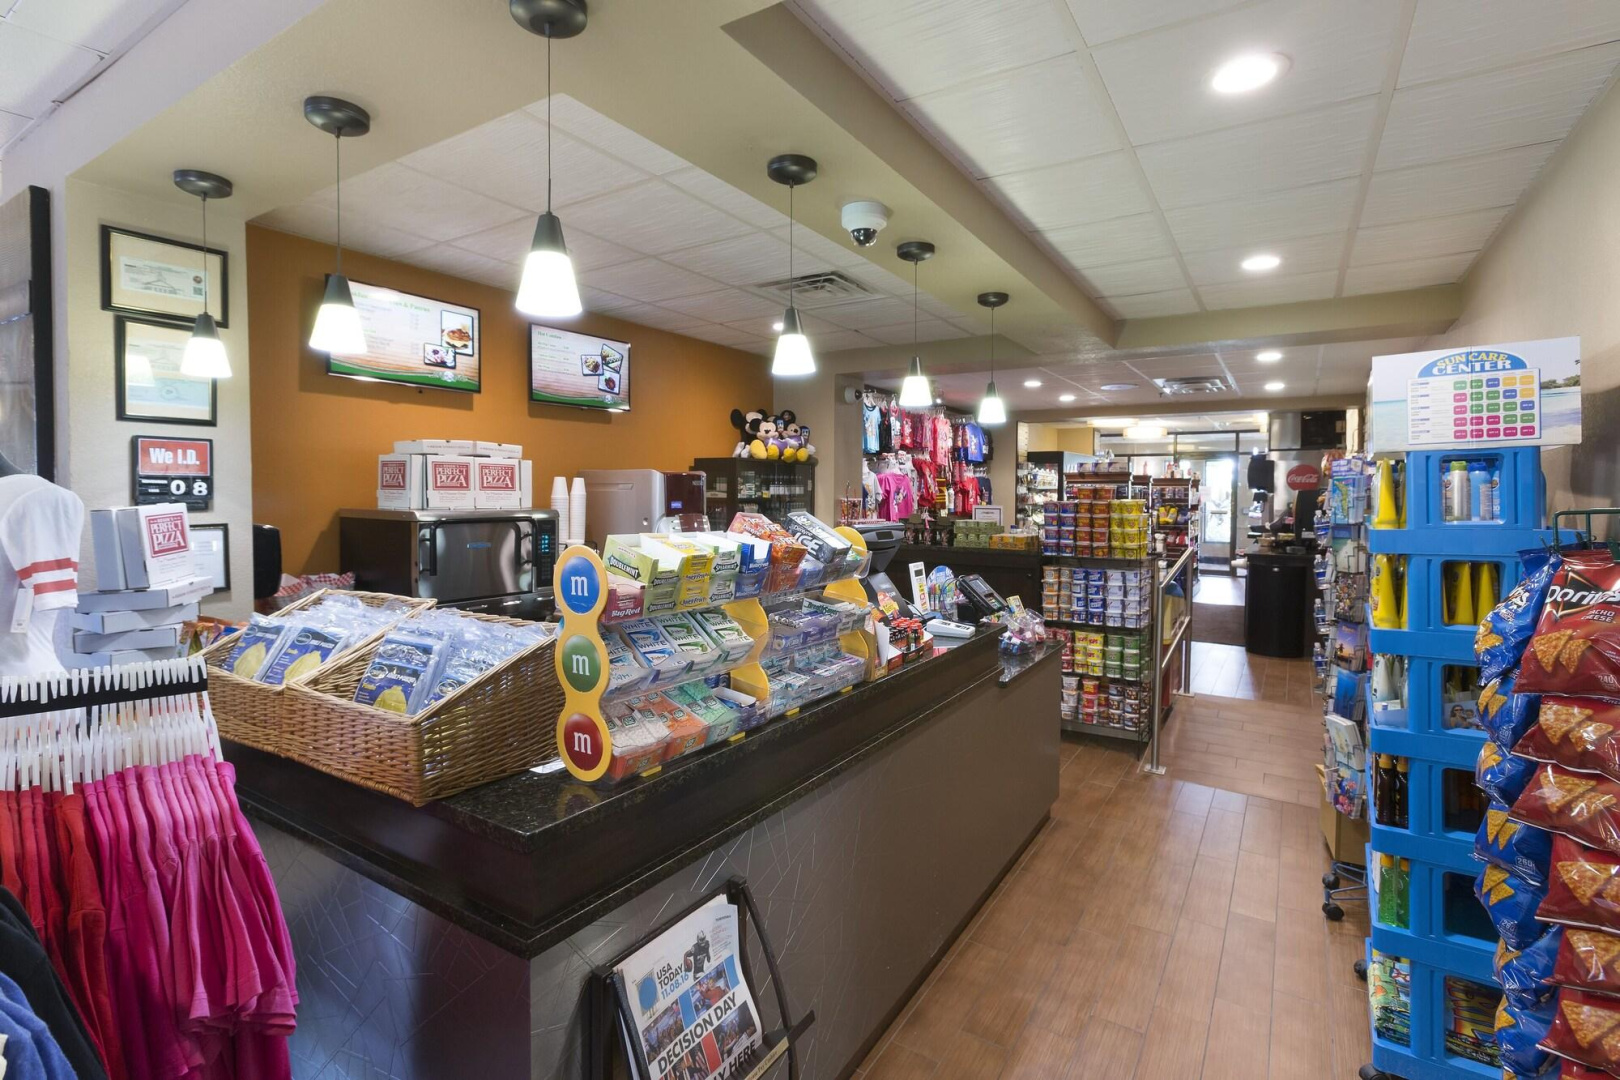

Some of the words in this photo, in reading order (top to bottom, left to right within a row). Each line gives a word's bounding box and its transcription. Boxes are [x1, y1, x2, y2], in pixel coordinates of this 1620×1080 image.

[1436, 354, 1466, 367] SUN
[1469, 352, 1507, 362] CARE
[1432, 360, 1512, 375] CENTER
[149, 447, 173, 464] We
[177, 449, 200, 465] I.D.
[436, 467, 466, 476] PERFECT
[482, 469, 512, 477] PERFECT
[384, 473, 404, 486] PIZZA
[436, 474, 467, 487] PIZZA
[482, 475, 513, 488] PIZZA
[150, 520, 182, 534] PERFECT
[152, 530, 185, 551] PIZZA
[610, 556, 639, 579] DOUBLEMINT
[570, 576, 588, 597] m
[1545, 585, 1620, 605] Doritos
[657, 616, 685, 624] WHITE
[1588, 609, 1615, 617] ACHO
[622, 621, 652, 630] WHITE
[637, 640, 667, 649] WHITE
[672, 633, 699, 642] WHITE
[608, 646, 628, 656] HITE
[572, 653, 590, 676] m
[573, 731, 592, 755] m
[656, 962, 673, 980] USA
[658, 963, 683, 989] TODAY
[661, 972, 690, 999] 11.08.16
[658, 1013, 714, 1074] DECISION
[713, 992, 737, 1022] DAY
[729, 1040, 757, 1075] HERE
